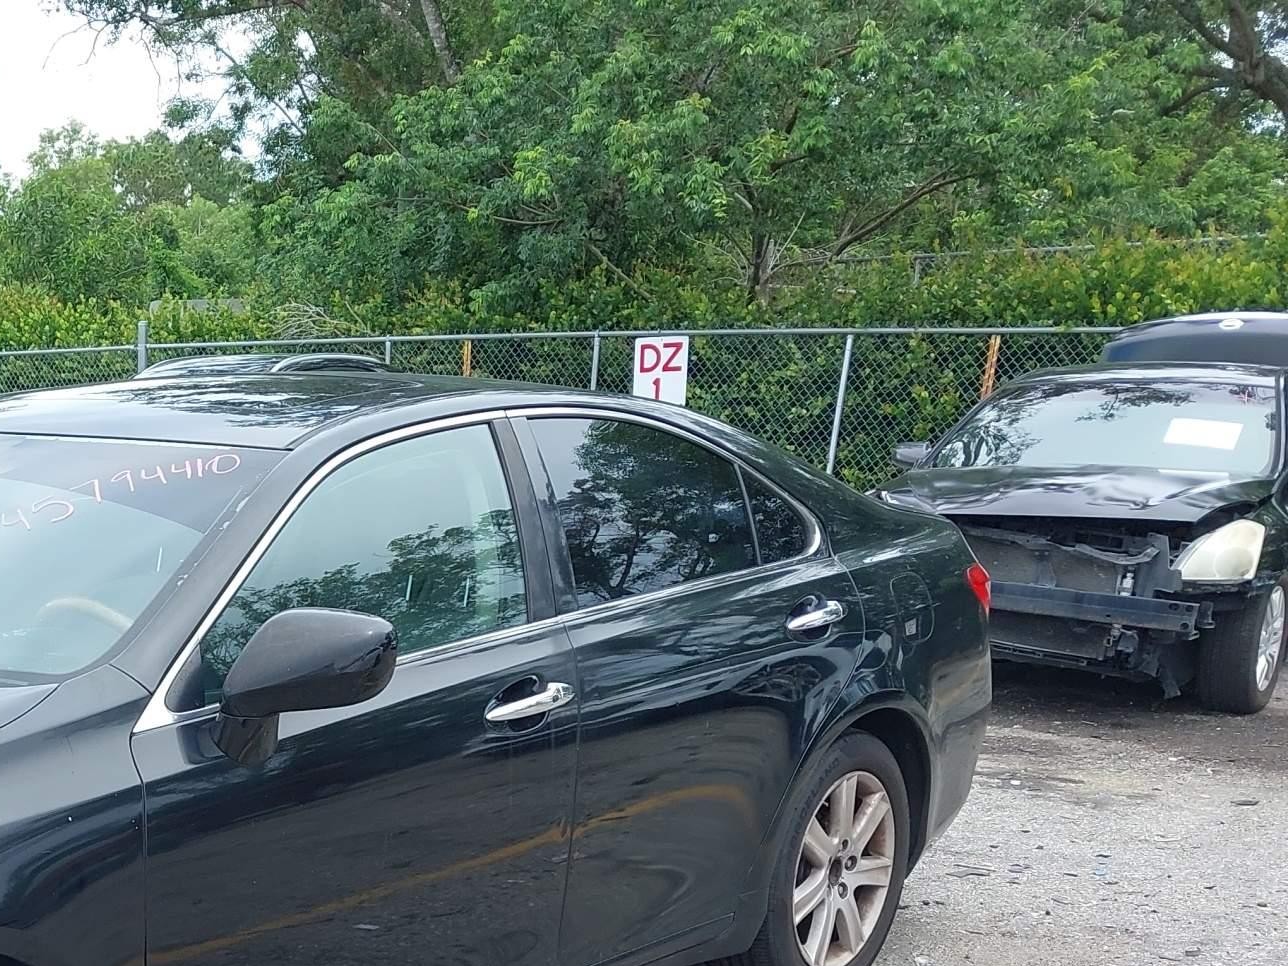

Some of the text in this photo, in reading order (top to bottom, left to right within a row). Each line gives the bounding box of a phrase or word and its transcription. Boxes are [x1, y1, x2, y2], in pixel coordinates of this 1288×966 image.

[639, 342, 684, 373] DZ
[652, 377, 662, 400] 1
[0, 453, 242, 531] 45794410
